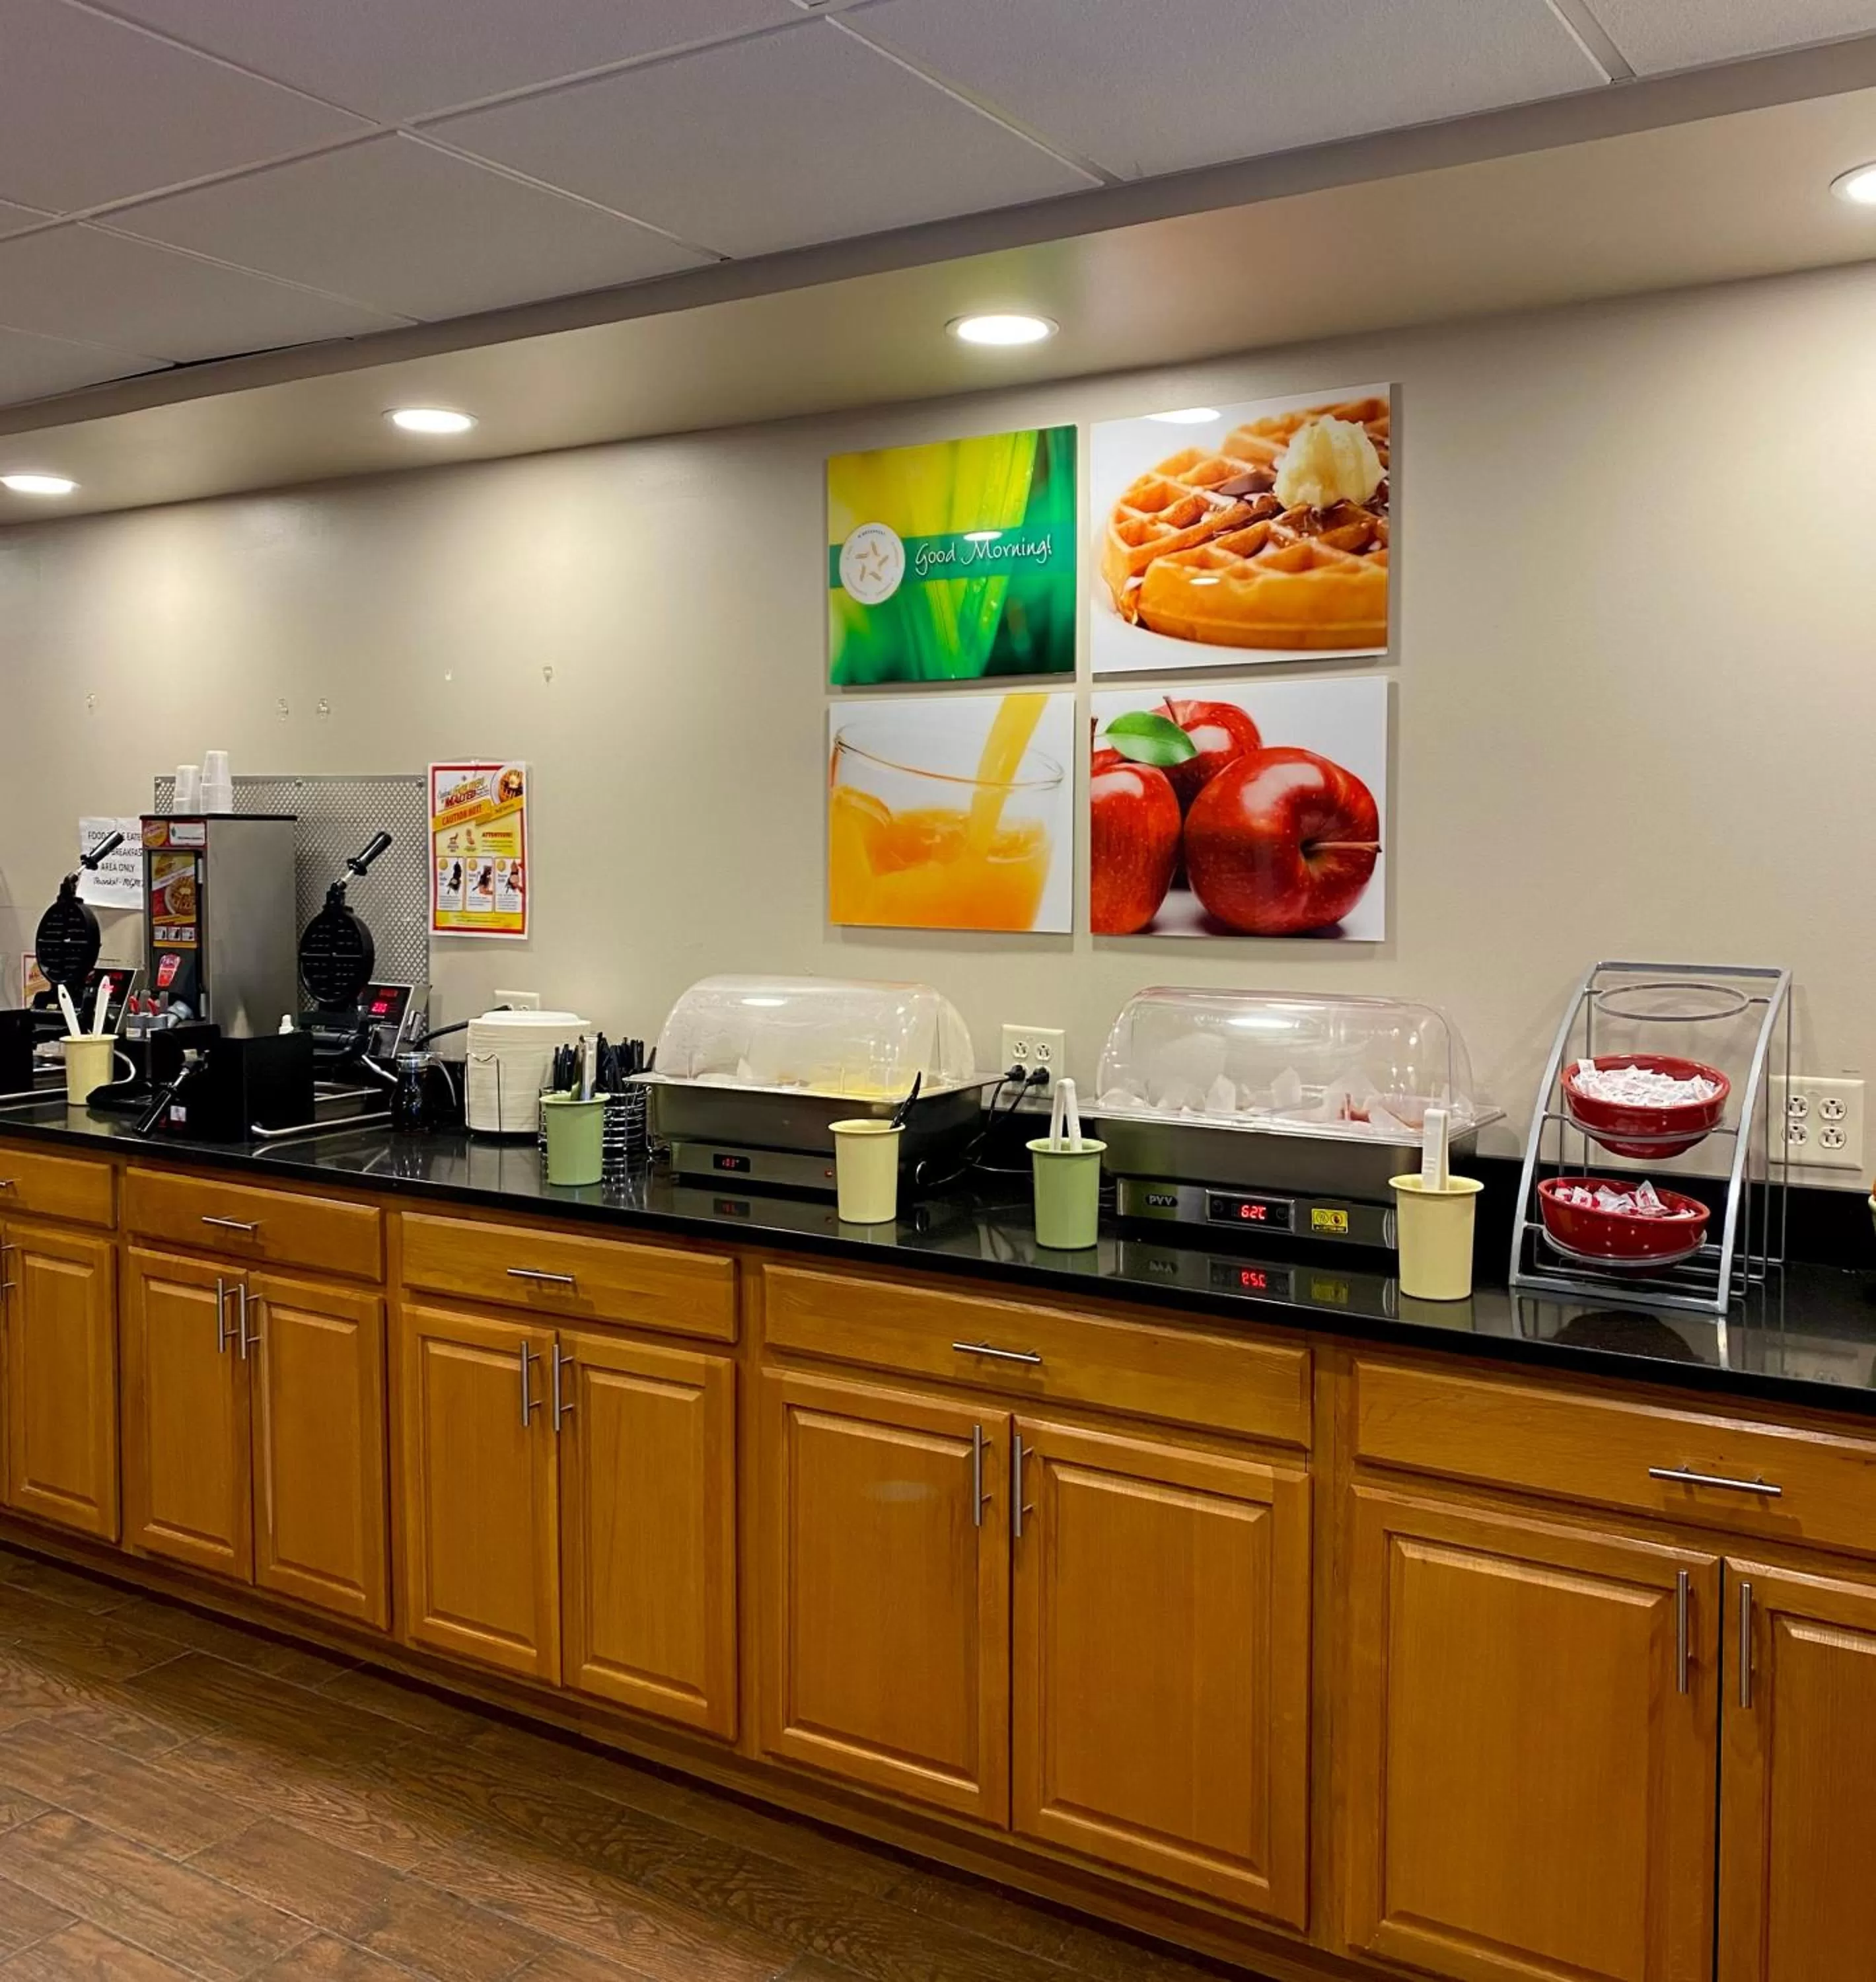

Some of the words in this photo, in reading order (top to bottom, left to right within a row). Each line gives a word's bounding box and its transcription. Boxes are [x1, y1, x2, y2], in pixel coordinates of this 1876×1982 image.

[916, 542, 956, 576] Good
[961, 534, 1052, 565] Morning!
[112, 848, 143, 857] BREAKFAS
[101, 862, 118, 871] AREA
[118, 863, 135, 873] ONLY
